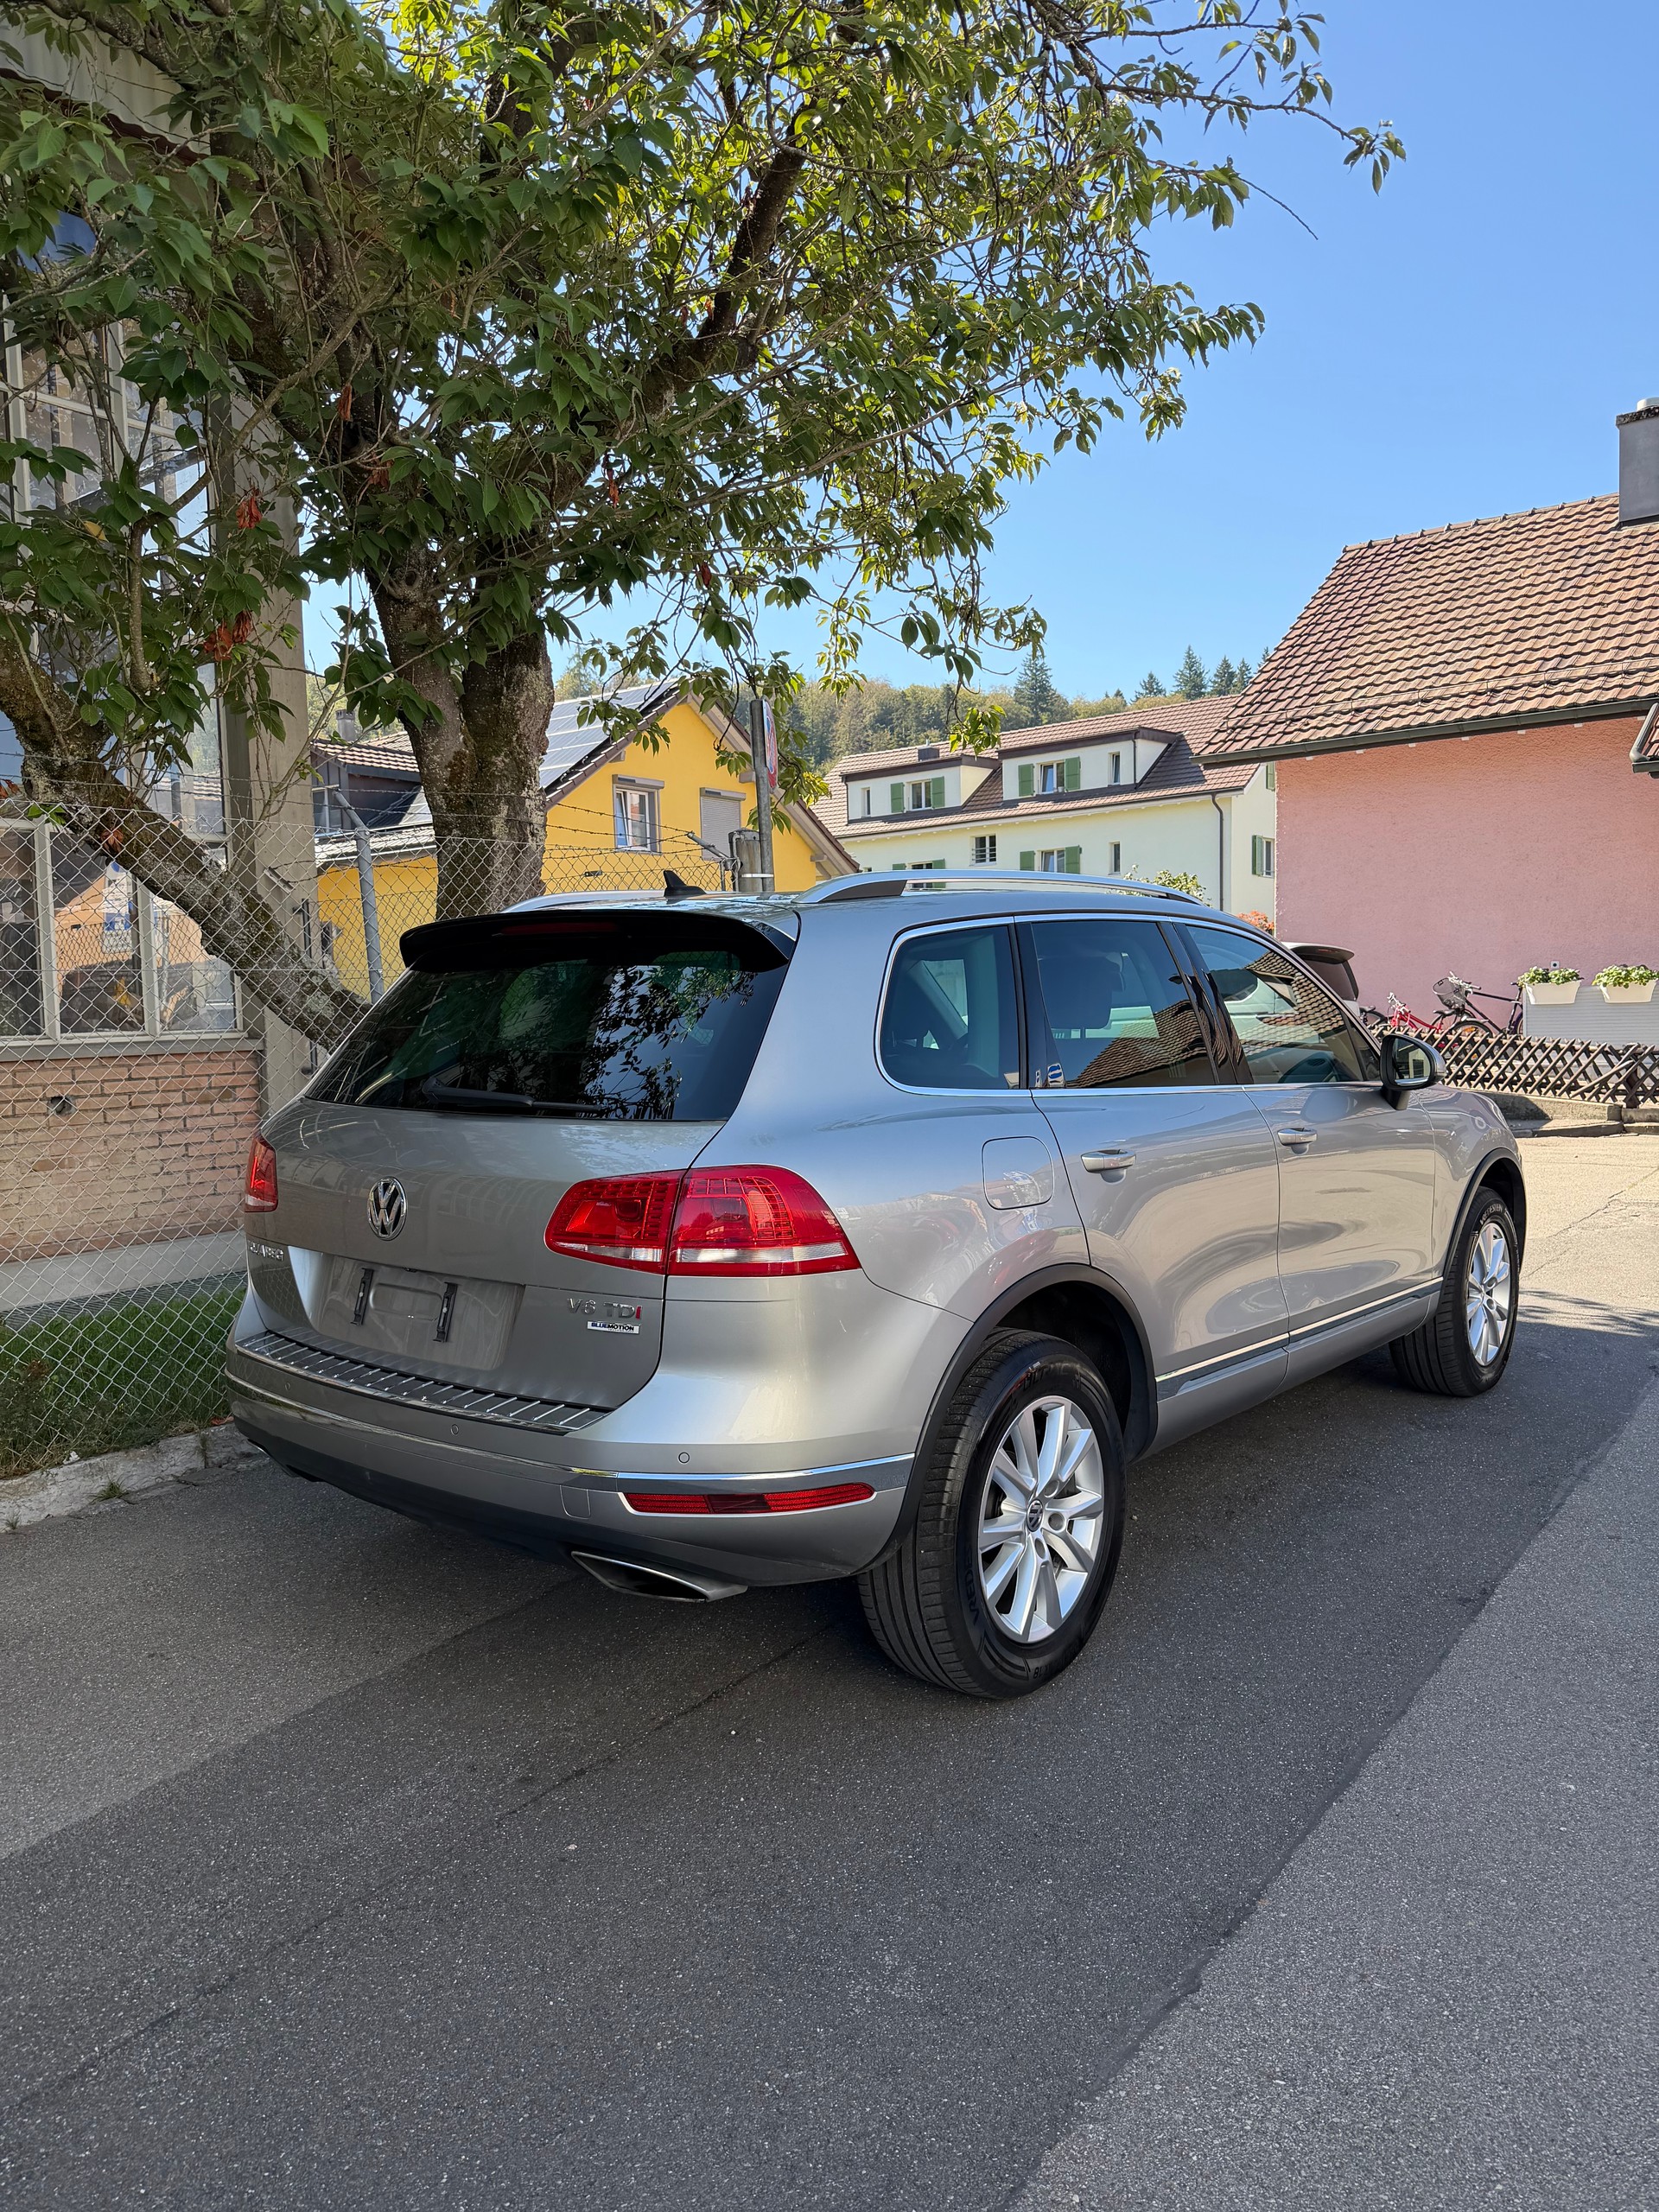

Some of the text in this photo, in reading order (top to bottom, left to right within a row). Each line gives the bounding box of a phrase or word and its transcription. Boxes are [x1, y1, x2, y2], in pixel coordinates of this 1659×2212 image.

[567, 1298, 642, 1319] V6 TDI
[591, 1322, 634, 1332] BLUEMOTION
